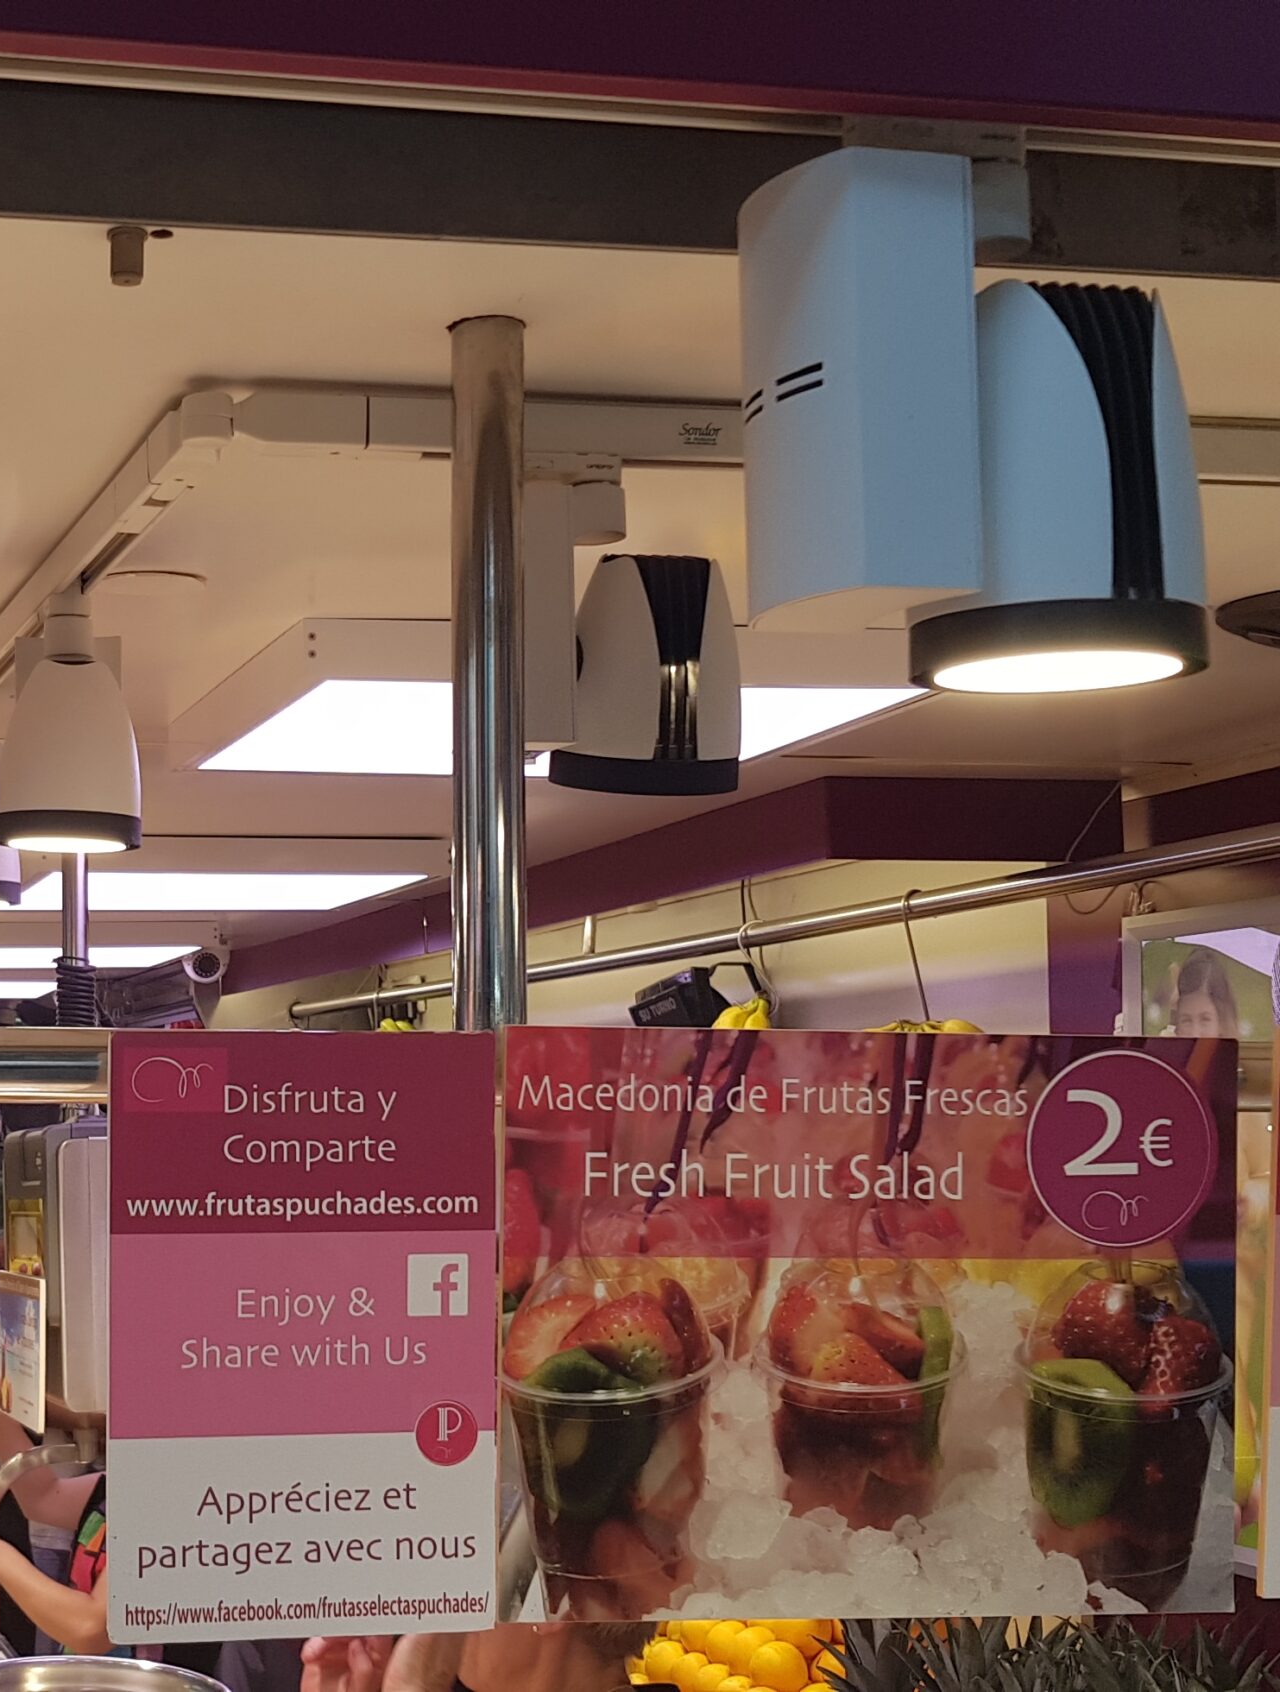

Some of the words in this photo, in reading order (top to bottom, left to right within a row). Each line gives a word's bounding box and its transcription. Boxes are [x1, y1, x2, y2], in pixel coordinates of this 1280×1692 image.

[223, 1082, 365, 1114] Disfruta
[379, 1090, 397, 1121] y
[517, 1073, 714, 1113] Macedonia
[726, 1075, 767, 1114] de
[781, 1078, 891, 1115] Frutas
[903, 1080, 1029, 1117] Frescas
[223, 1134, 397, 1171] Comparte
[585, 1149, 706, 1198] Fresh
[725, 1153, 833, 1200] Fruit
[847, 1152, 964, 1201] Salad
[126, 1191, 479, 1221] www.frutaspuchades.com
[237, 1287, 336, 1326] Enjoy
[348, 1287, 376, 1317] &
[181, 1336, 280, 1369] Share
[291, 1335, 370, 1366] with
[384, 1336, 427, 1365] Us
[196, 1481, 372, 1525] Appréciez
[382, 1483, 417, 1511] et
[137, 1539, 293, 1579] partagez
[303, 1537, 382, 1564] avec
[394, 1534, 477, 1561] nous
[124, 1591, 490, 1631] https://www.facebook.com/frutasselectaspuchades/
